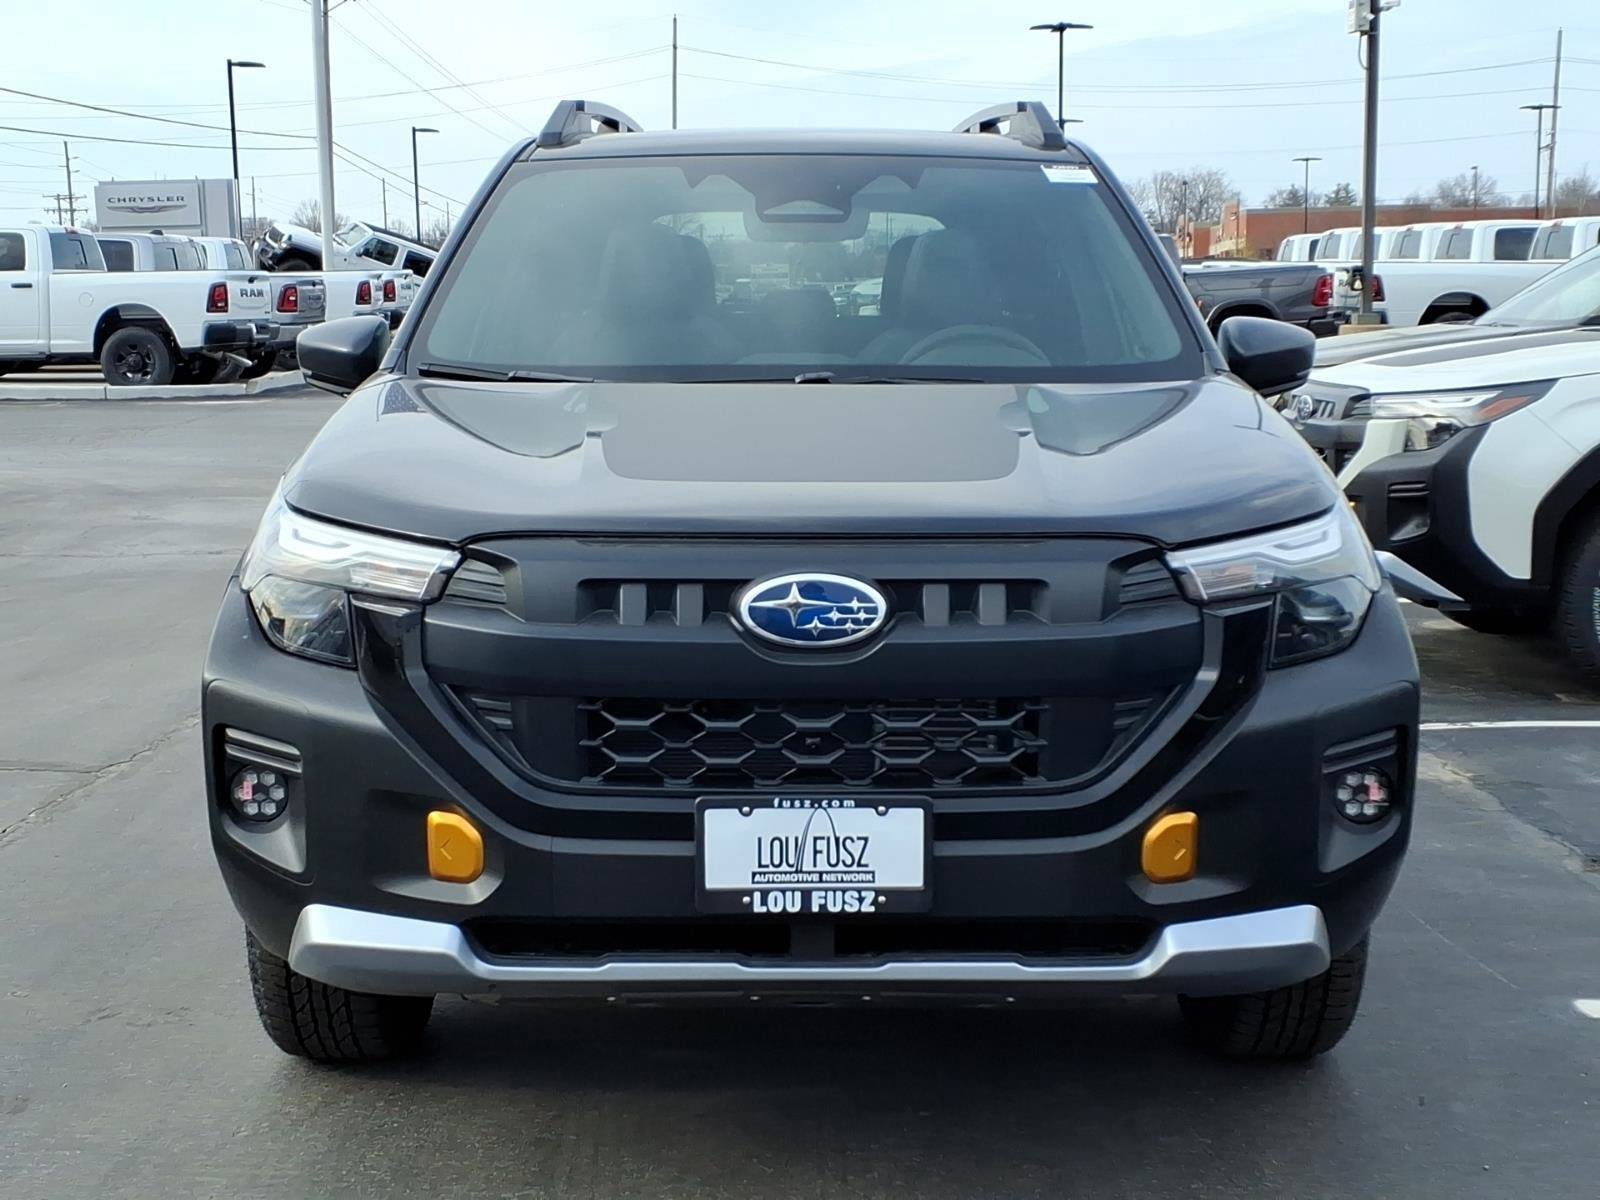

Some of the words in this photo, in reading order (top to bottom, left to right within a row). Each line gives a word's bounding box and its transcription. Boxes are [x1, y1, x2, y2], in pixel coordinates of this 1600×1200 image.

[108, 195, 184, 203] CHRYSLER
[240, 288, 264, 297] RAM
[773, 797, 855, 808] fusz.com
[758, 836, 799, 868] LOU
[813, 836, 869, 868] FUSZ
[754, 873, 820, 882] AUTOMOTIVE
[822, 873, 873, 882] NETWORK
[753, 890, 802, 913] LOU
[811, 890, 875, 913] FUSZ
